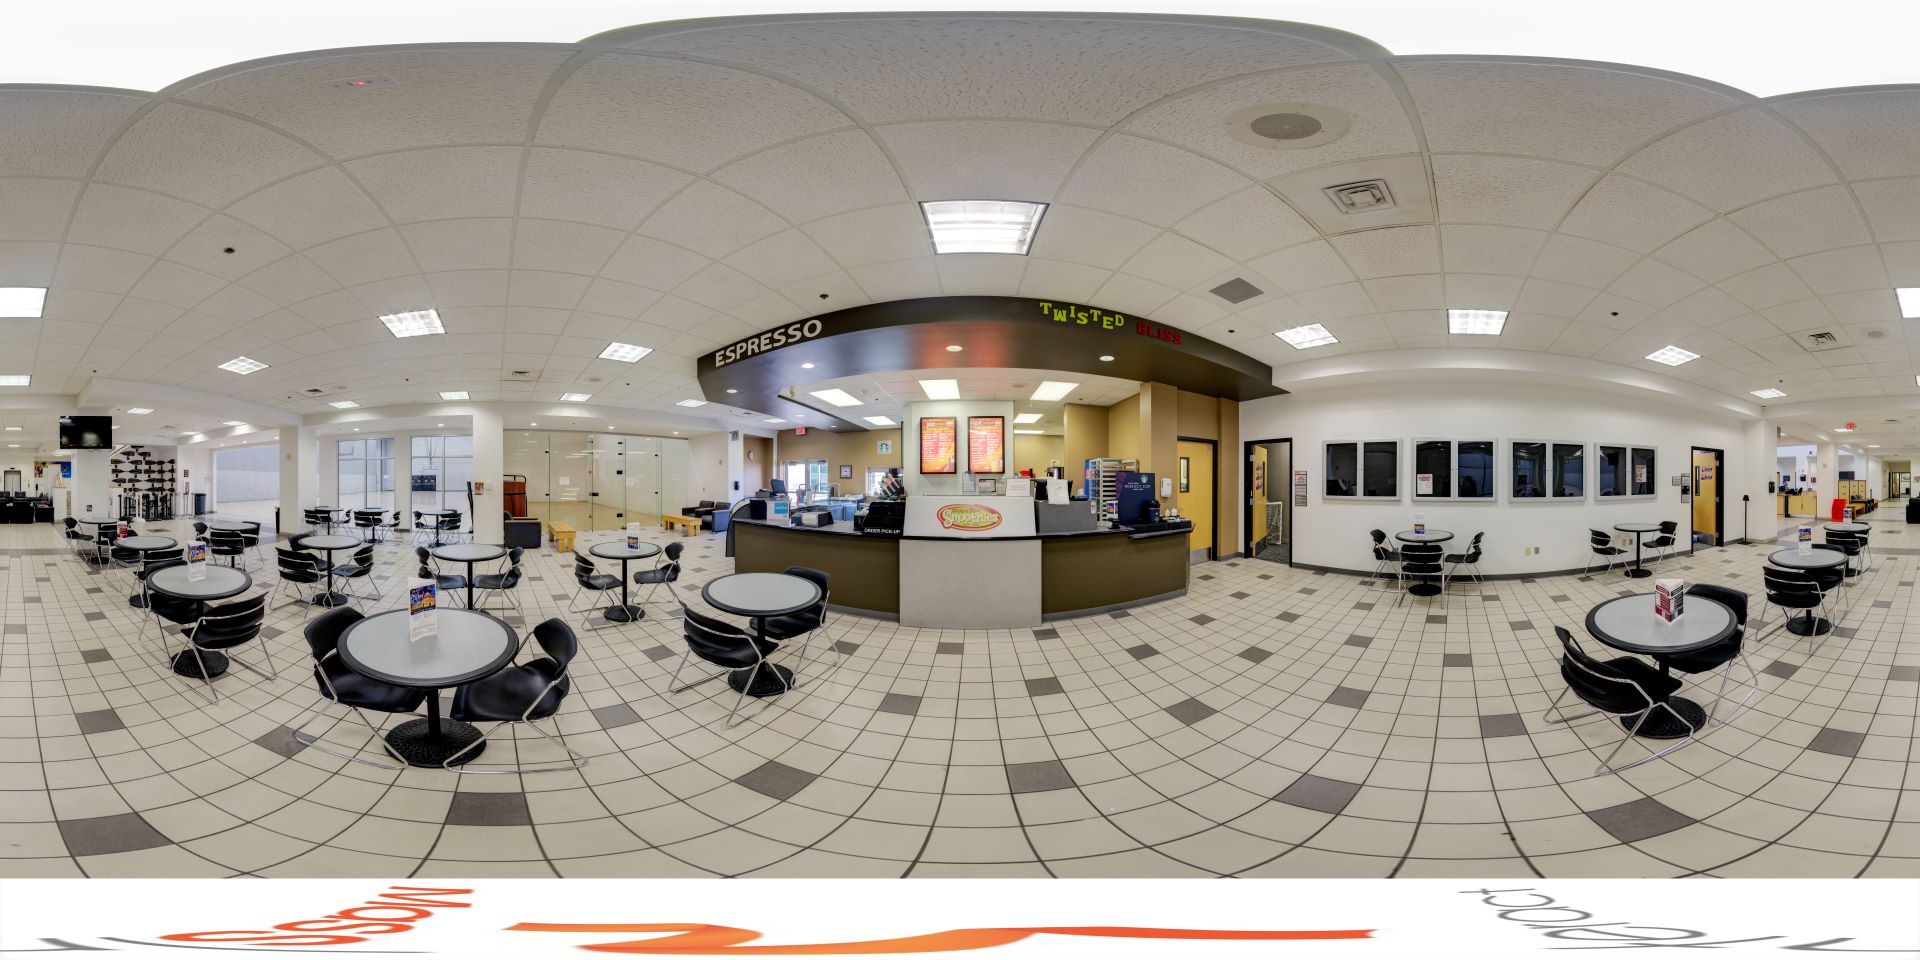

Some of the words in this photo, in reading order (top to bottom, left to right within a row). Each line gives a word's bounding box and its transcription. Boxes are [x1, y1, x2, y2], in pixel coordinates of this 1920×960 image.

[715, 319, 823, 368] ESPRESSO
[1039, 302, 1125, 330] TWISTED
[1136, 321, 1183, 346] BLISS
